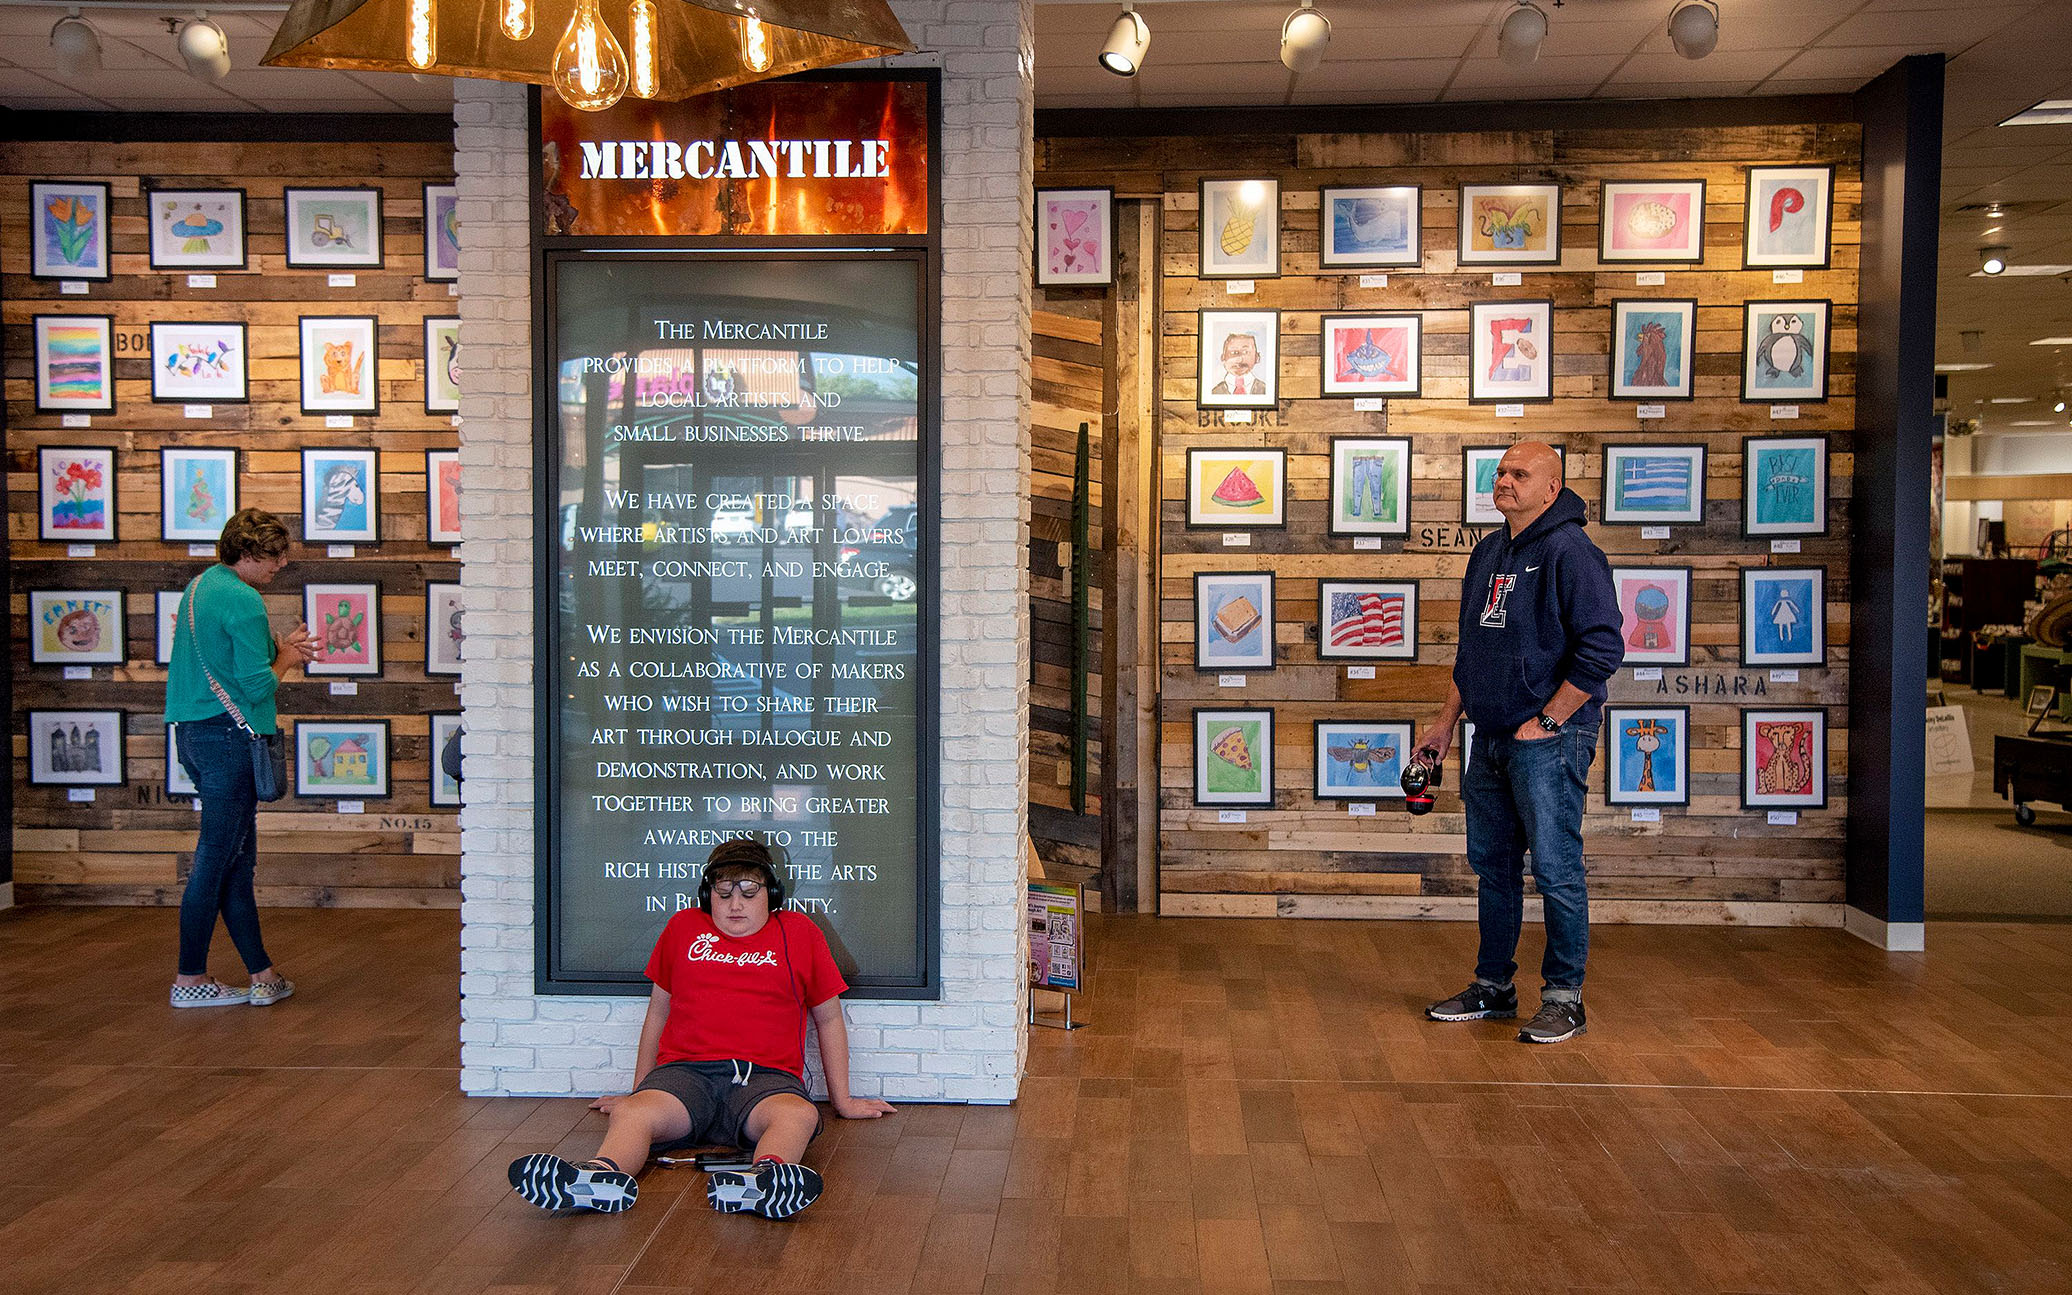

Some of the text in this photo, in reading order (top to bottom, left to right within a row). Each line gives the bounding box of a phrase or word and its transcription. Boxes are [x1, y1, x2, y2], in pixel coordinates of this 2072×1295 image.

[579, 140, 890, 179] MERCANTILE
[655, 321, 828, 340] THE MERCANTILE
[583, 357, 900, 374] PROVIDES A PLATFORM TO HELP
[642, 392, 840, 408] LOCAL ARTISTS AND
[614, 426, 868, 442] SMALL BUSINESSES THRIVE.
[605, 490, 878, 510] WE HAVE CREATED A SPACE
[580, 527, 903, 544] WHERE ARTISTS AND ART LOVERS
[588, 561, 643, 578] MEET,
[653, 561, 752, 579] CONNECT,
[762, 562, 803, 577] AND
[587, 625, 896, 645] WE ENVISION THE MERCANTILE
[578, 662, 904, 679] AS A COLLABORATIVE OF MAKERS
[1656, 674, 1767, 696] ASHARA
[604, 695, 878, 713] WHO WISH TO SHARE THEIR
[591, 729, 891, 746] ART THROUGH DIALOGUE AND
[597, 762, 885, 781] DEMONSTRATION, AND WORK
[592, 795, 890, 814] TOGETHER TO BRING GREATER
[763, 831, 791, 846] TO
[801, 831, 838, 847] THE
[605, 862, 649, 878] RICH
[786, 864, 821, 880] THE
[831, 865, 877, 881] ARTS
[646, 896, 665, 911] IN
